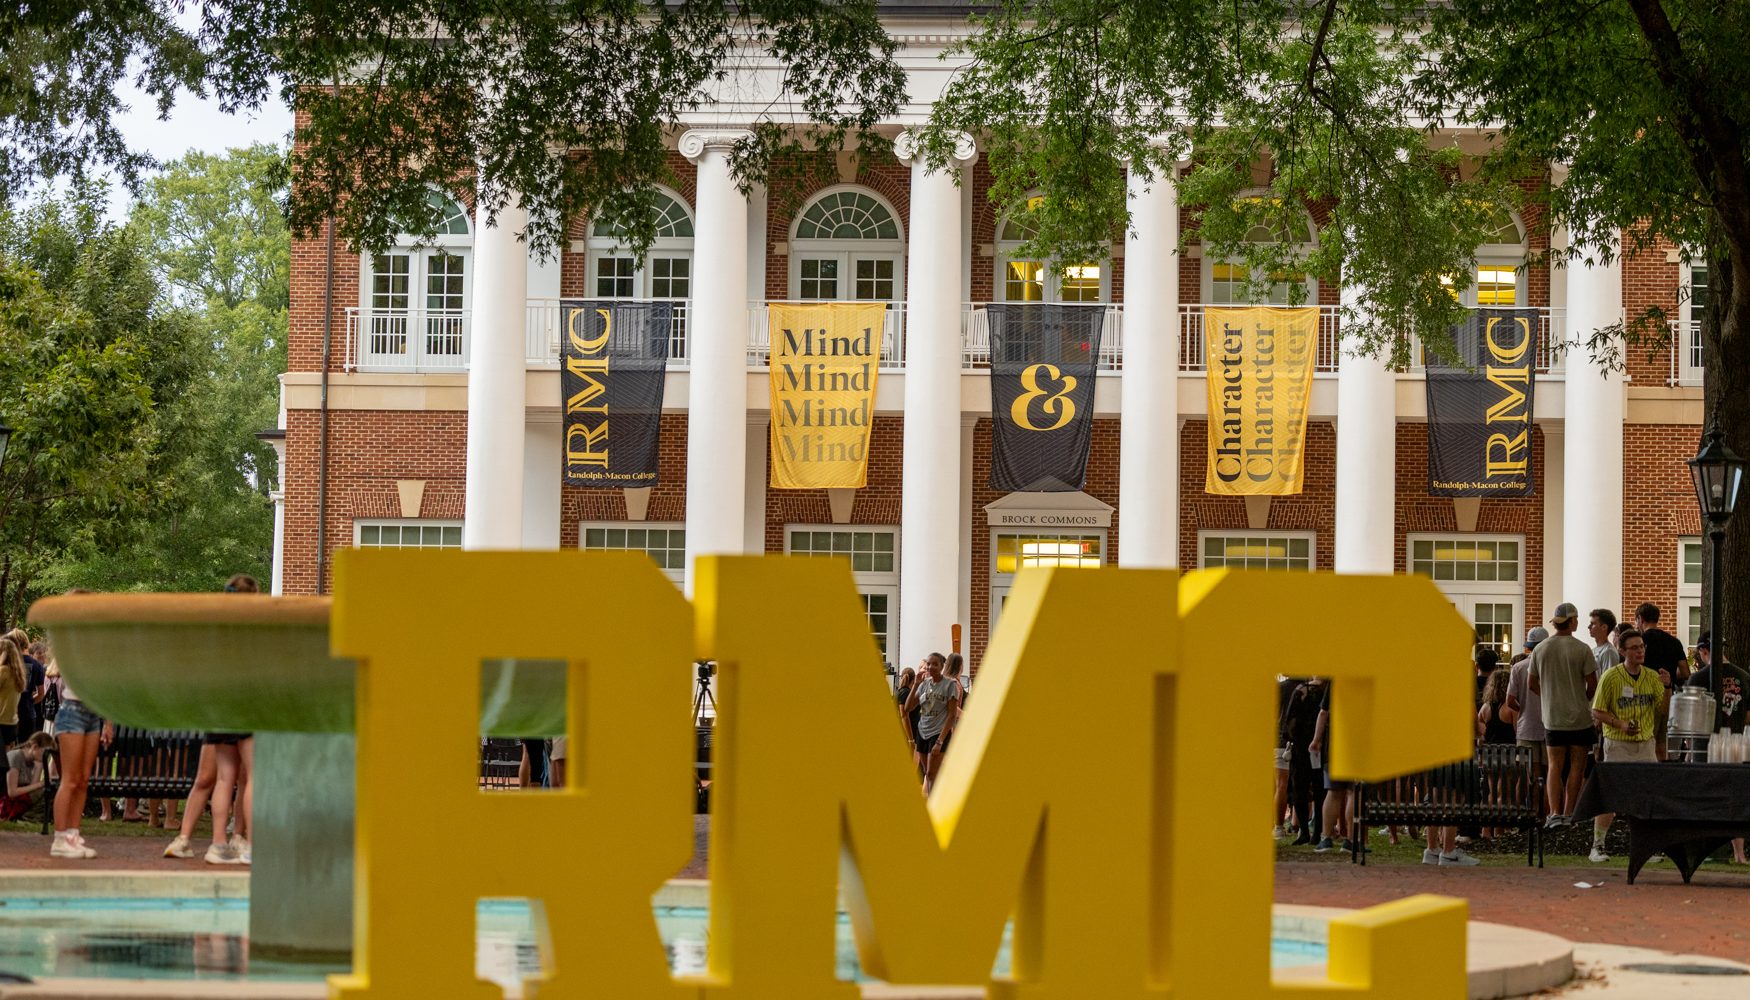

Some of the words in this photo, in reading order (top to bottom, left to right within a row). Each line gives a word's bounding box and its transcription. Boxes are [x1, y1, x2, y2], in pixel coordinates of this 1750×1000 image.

[780, 328, 873, 357] Mind
[567, 308, 611, 469] RMC
[779, 363, 870, 392] Mind
[1010, 363, 1077, 431] &
[1216, 322, 1243, 483] Character
[1245, 322, 1275, 483] Character
[1277, 322, 1308, 483] Character
[1486, 317, 1529, 478] RMC
[779, 398, 868, 427] Mind
[780, 434, 867, 463] Mind
[1432, 480, 1498, 490] Randolph-Macon
[1002, 515, 1036, 524] BROCK
[1040, 515, 1097, 525] COMMONS
[330, 549, 1475, 1000] RMC
